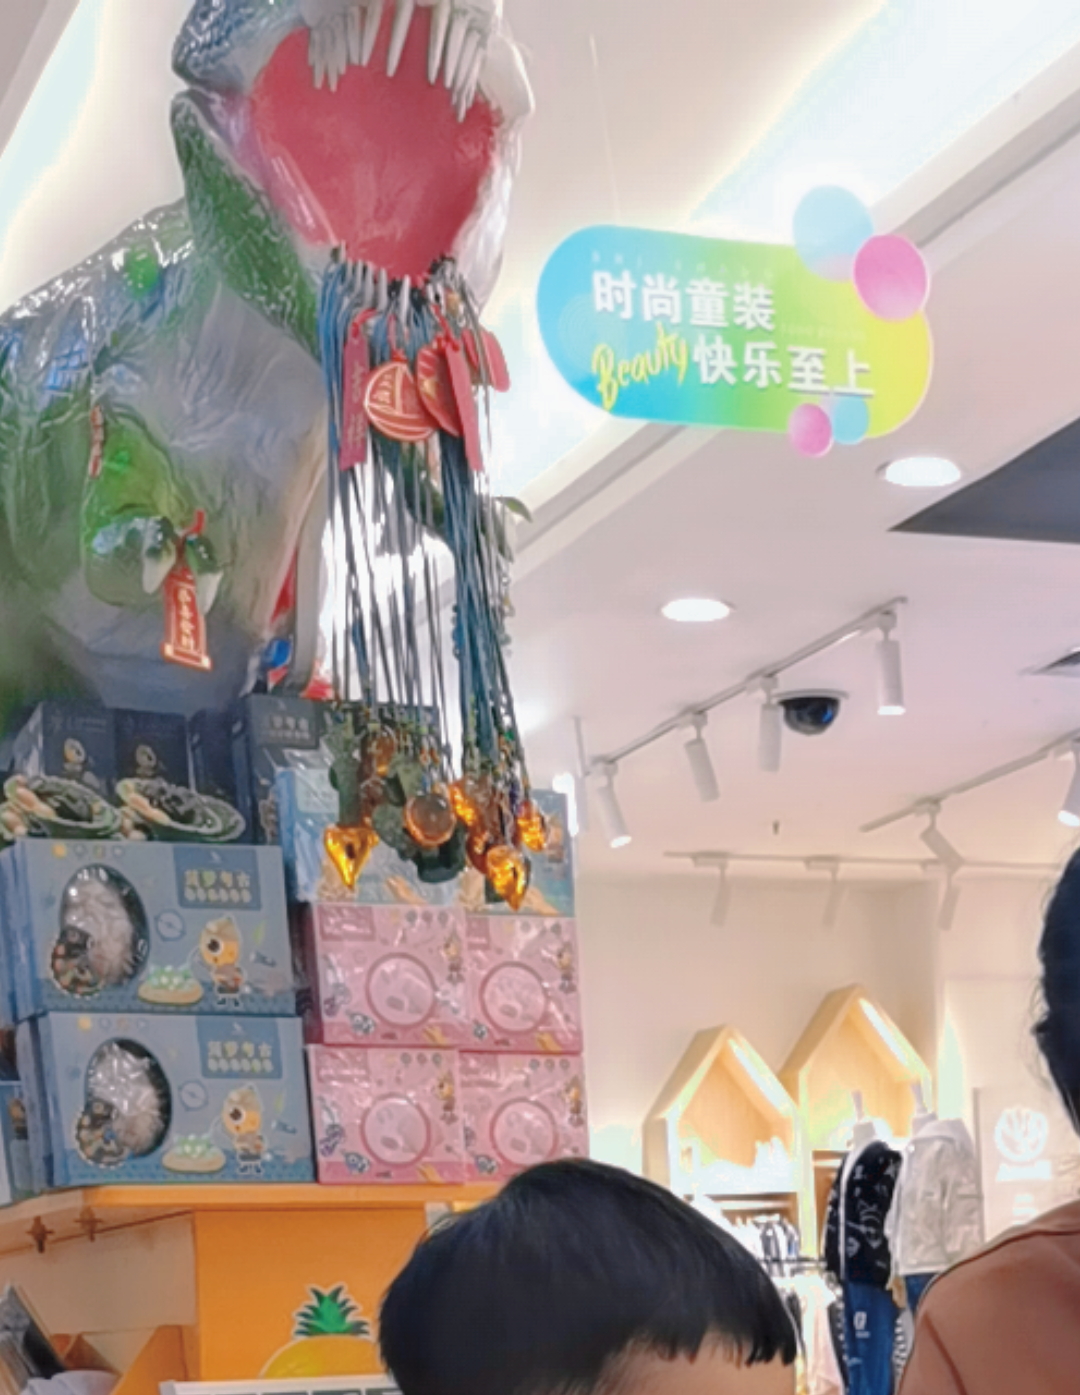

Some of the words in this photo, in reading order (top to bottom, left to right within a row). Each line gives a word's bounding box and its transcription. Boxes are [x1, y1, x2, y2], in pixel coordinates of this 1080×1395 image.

[592, 270, 776, 332] 时尚童装
[592, 321, 688, 412] Beauty
[693, 335, 875, 397] 快乐至上
